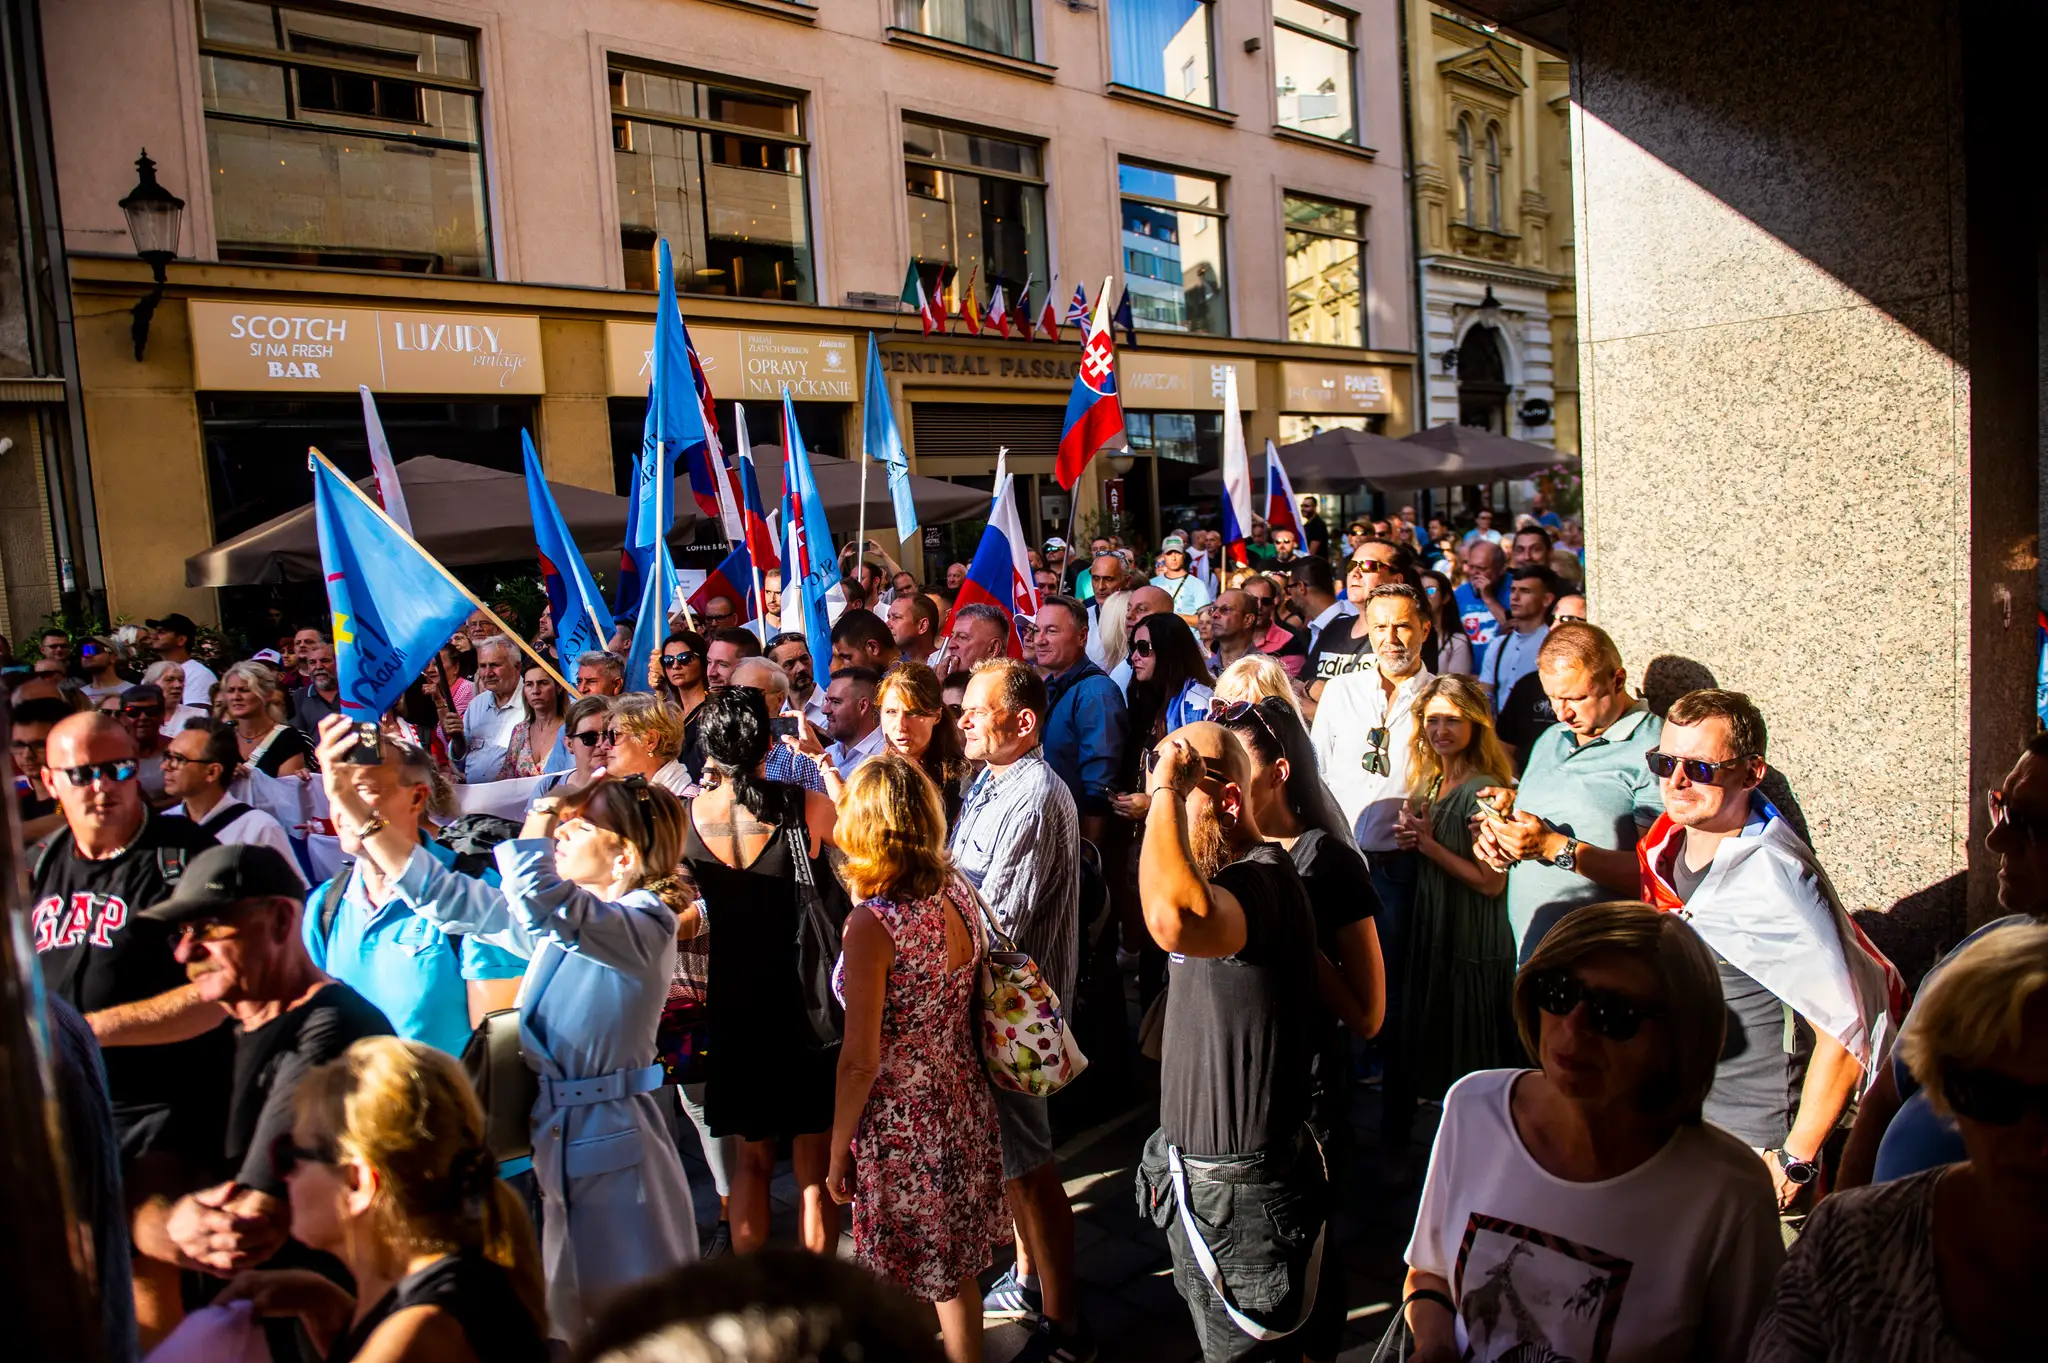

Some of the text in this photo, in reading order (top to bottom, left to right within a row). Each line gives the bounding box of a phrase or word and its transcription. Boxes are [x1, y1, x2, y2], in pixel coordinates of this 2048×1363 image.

[230, 315, 347, 341] SCOTCH
[394, 321, 502, 353] LUXURY
[250, 342, 334, 358] SI NA FRESH
[268, 361, 321, 379] BAR
[472, 351, 527, 388] vintage
[748, 358, 809, 376] OPRAVY
[880, 351, 1080, 380] CENTRAL PASSAG
[749, 376, 853, 396] NA POČKANIE
[32, 891, 128, 953] GAP
